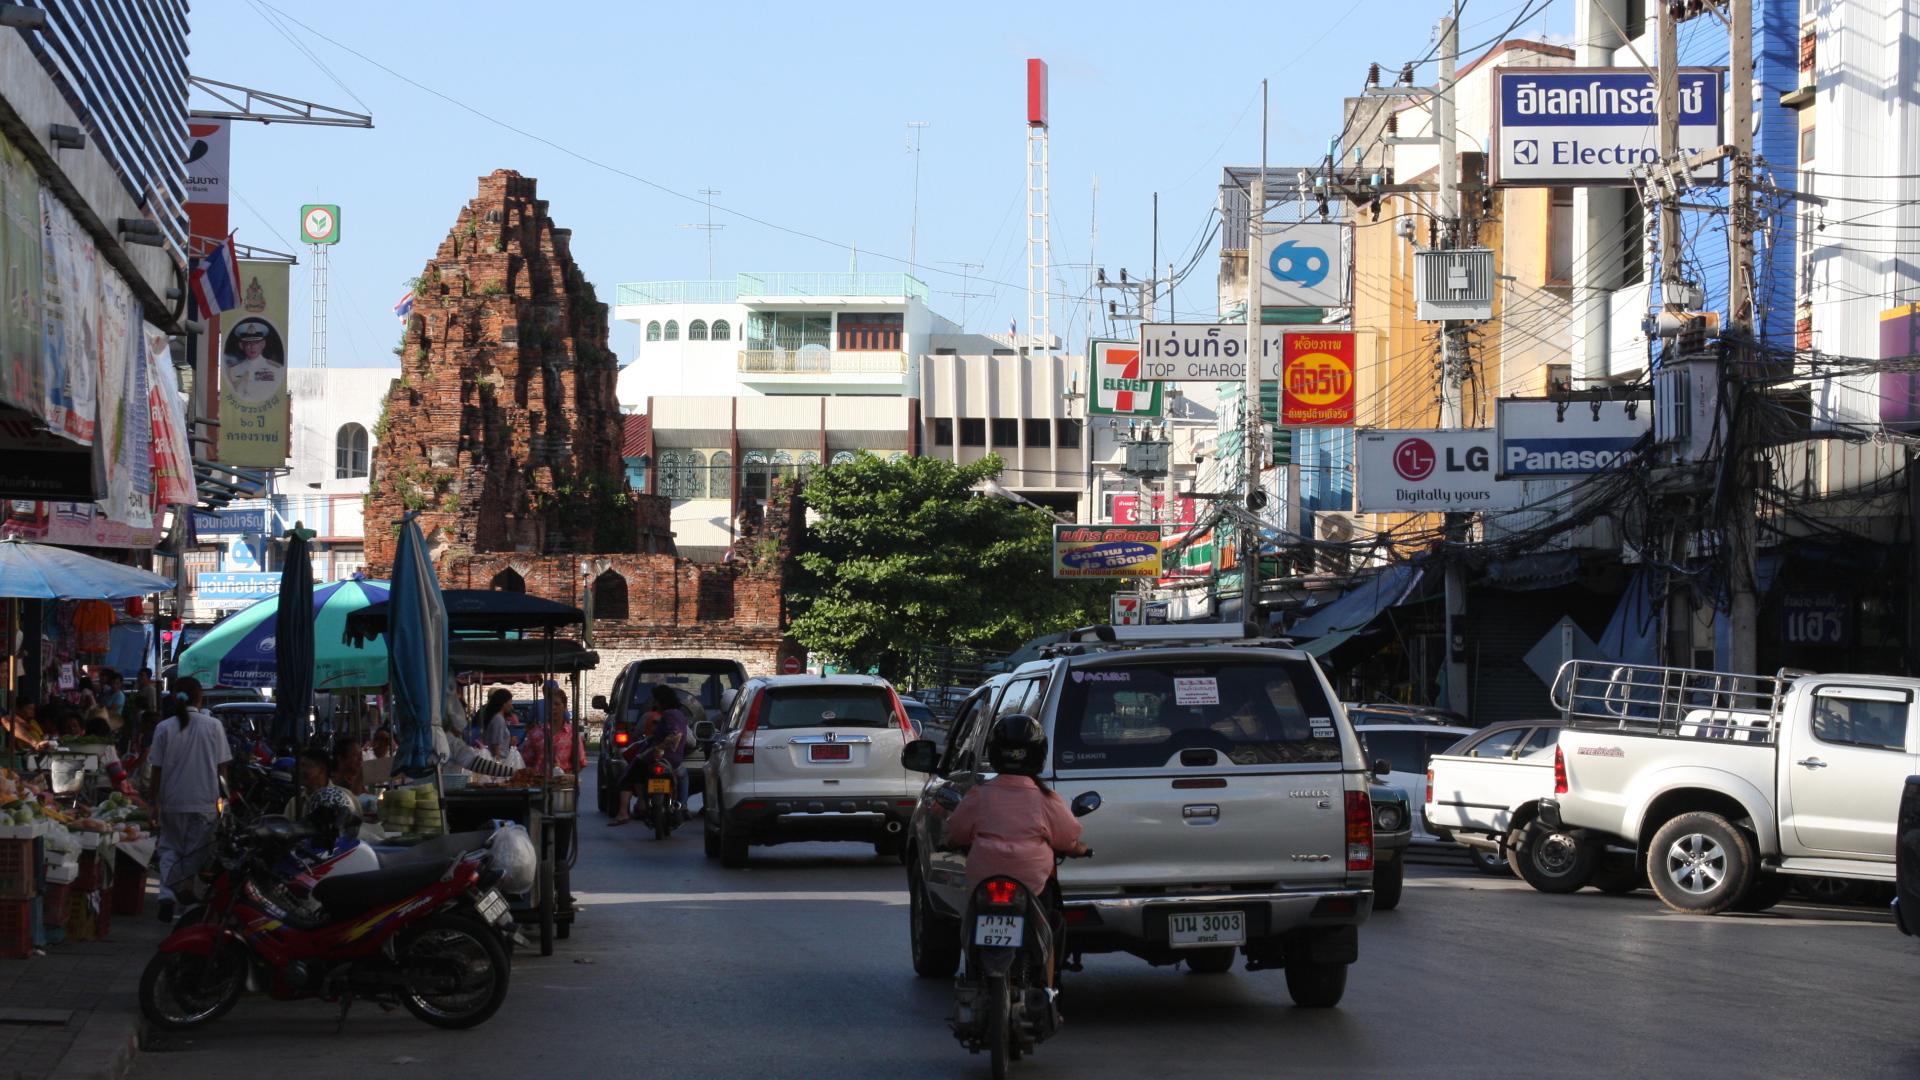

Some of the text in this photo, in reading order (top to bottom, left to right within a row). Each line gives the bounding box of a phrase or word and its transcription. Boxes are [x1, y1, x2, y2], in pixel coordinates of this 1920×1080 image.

[1146, 363, 1247, 377] TOP CHAROE
[226, 430, 279, 442] ครองราชย์
[1446, 447, 1489, 472] LG
[1396, 488, 1490, 504] Digitally yours
[1289, 790, 1330, 798] HILUX
[1174, 915, 1240, 932] บน 3003
[984, 936, 1012, 945] 677
